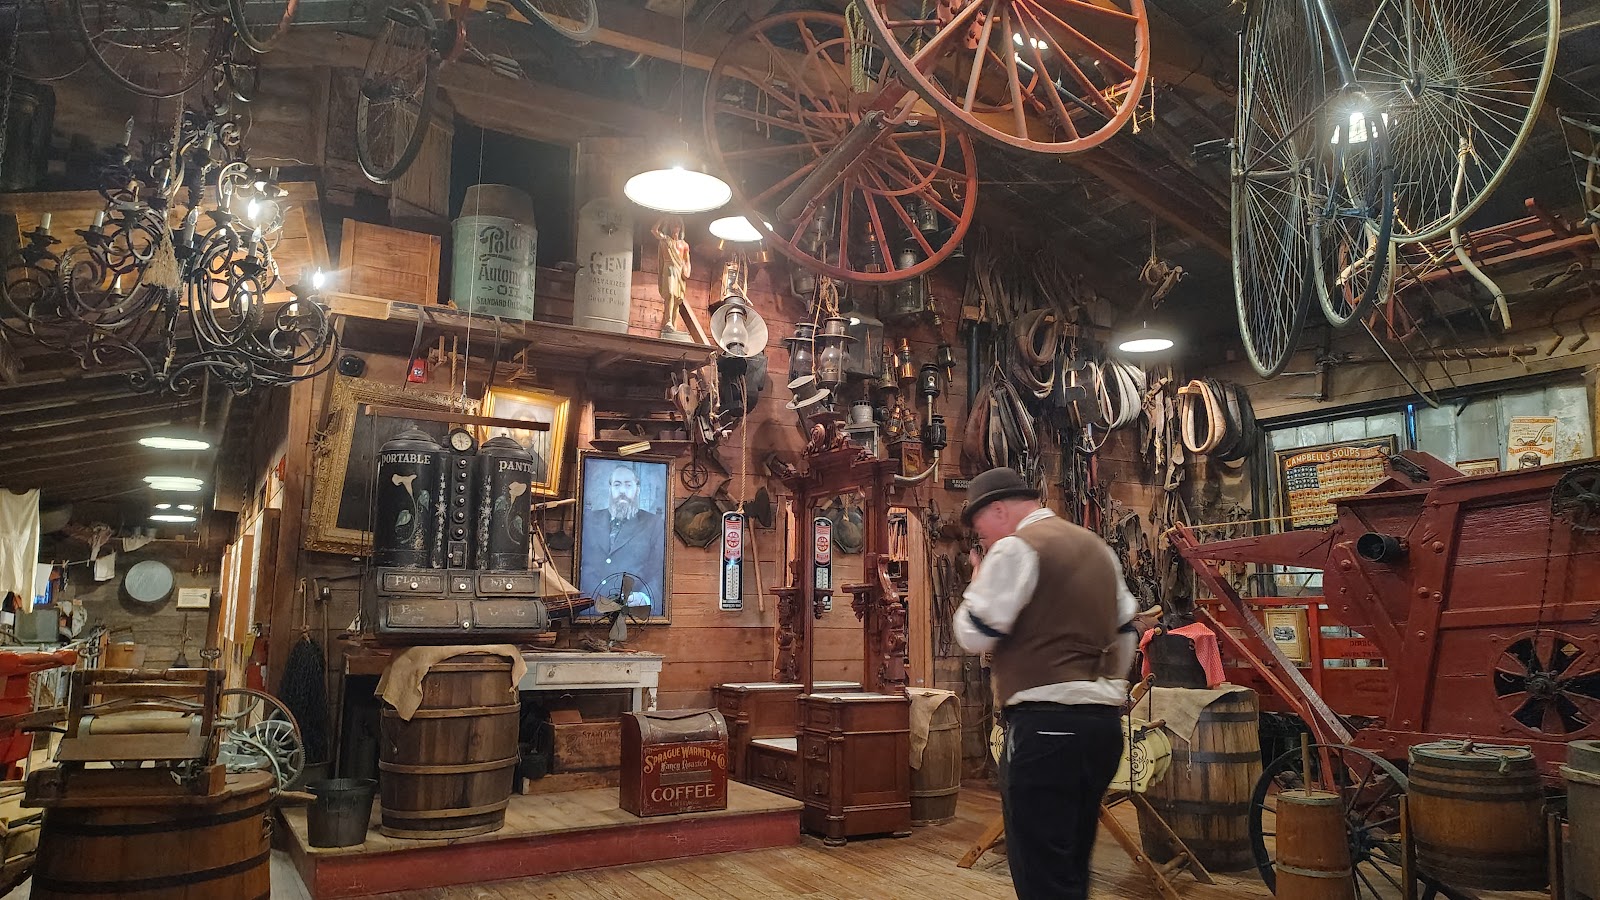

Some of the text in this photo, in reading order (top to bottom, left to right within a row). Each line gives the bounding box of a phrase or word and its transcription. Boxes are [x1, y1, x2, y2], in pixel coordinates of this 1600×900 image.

[480, 226, 536, 253] Polare
[590, 252, 627, 275] GEM
[478, 264, 534, 291] Automle
[597, 287, 617, 296] STEEL
[476, 296, 507, 307] STANDARD
[381, 453, 431, 466] PORTABLE
[1332, 448, 1361, 459] SOUPS
[643, 747, 680, 774] SPRAGUE
[681, 746, 711, 759] WARNER
[660, 759, 708, 772] Fancy Roasted
[651, 784, 716, 802] COFFEE
